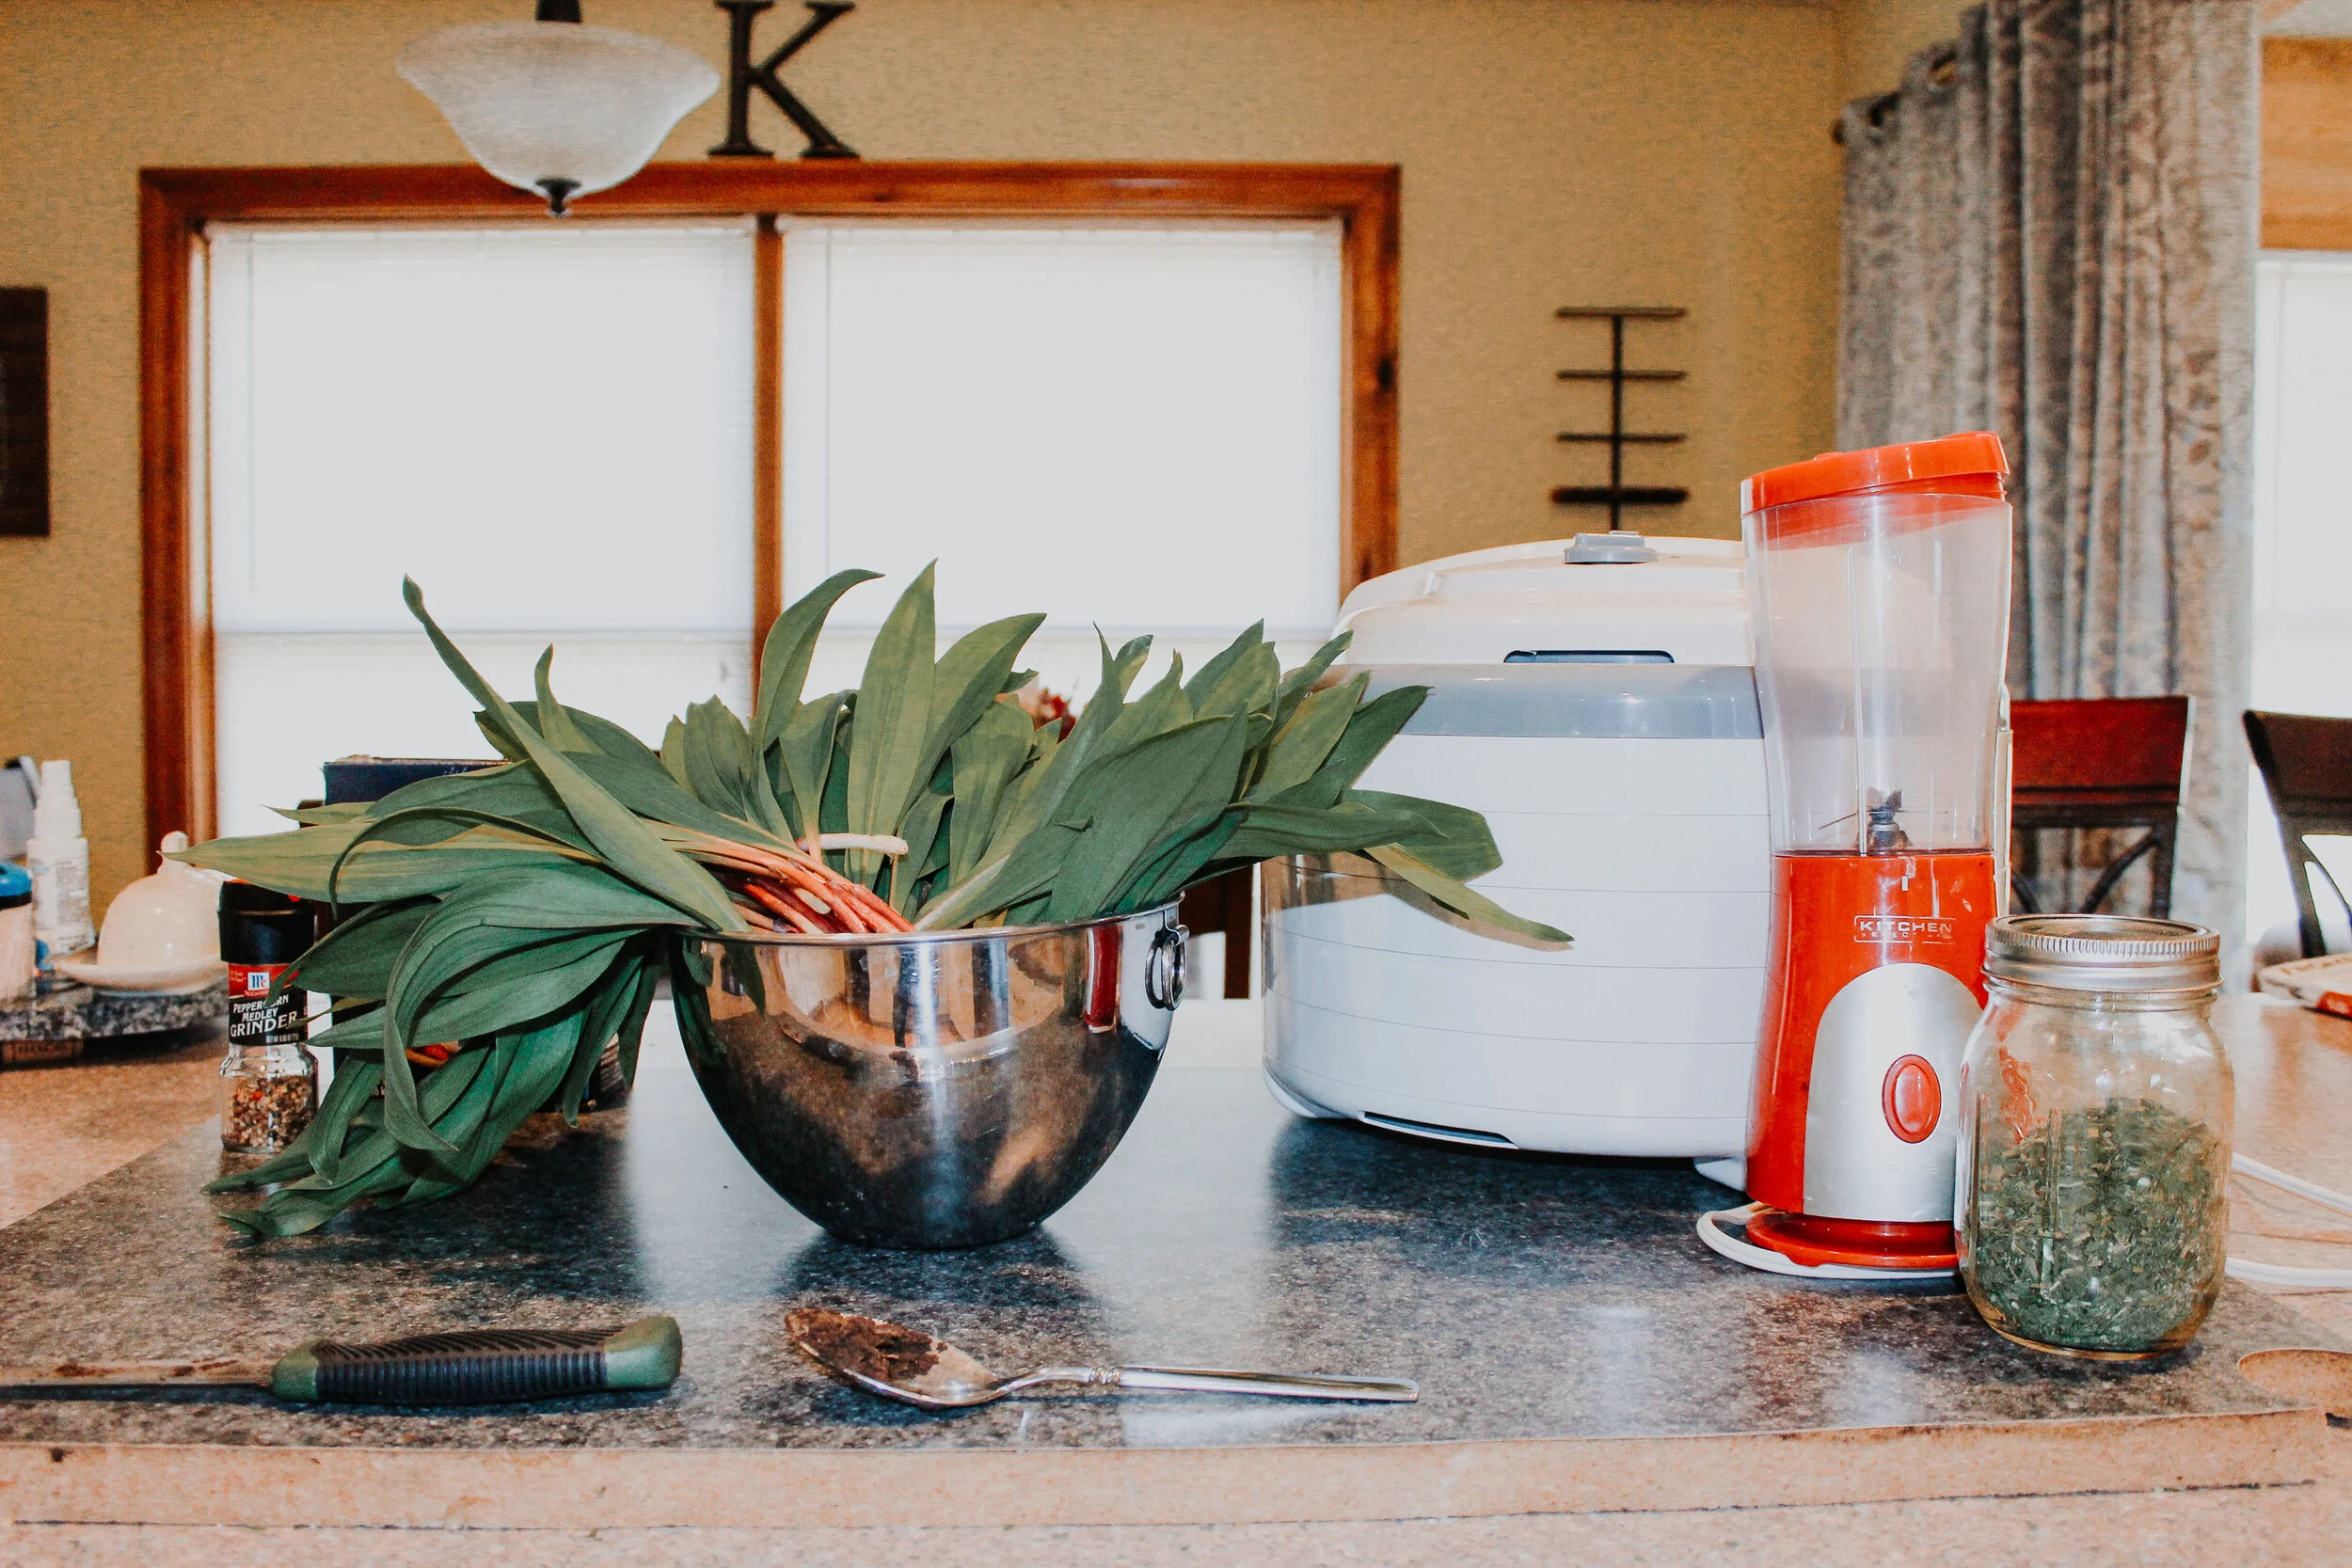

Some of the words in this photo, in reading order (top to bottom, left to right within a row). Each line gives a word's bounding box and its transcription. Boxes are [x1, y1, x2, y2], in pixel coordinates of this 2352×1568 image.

[707, 0, 860, 158] K
[1859, 921, 1952, 933] KITCHEN
[232, 993, 289, 1013] PEPPERRN
[230, 1010, 297, 1037] GRINDER
[241, 1007, 278, 1022] MEDLEY
